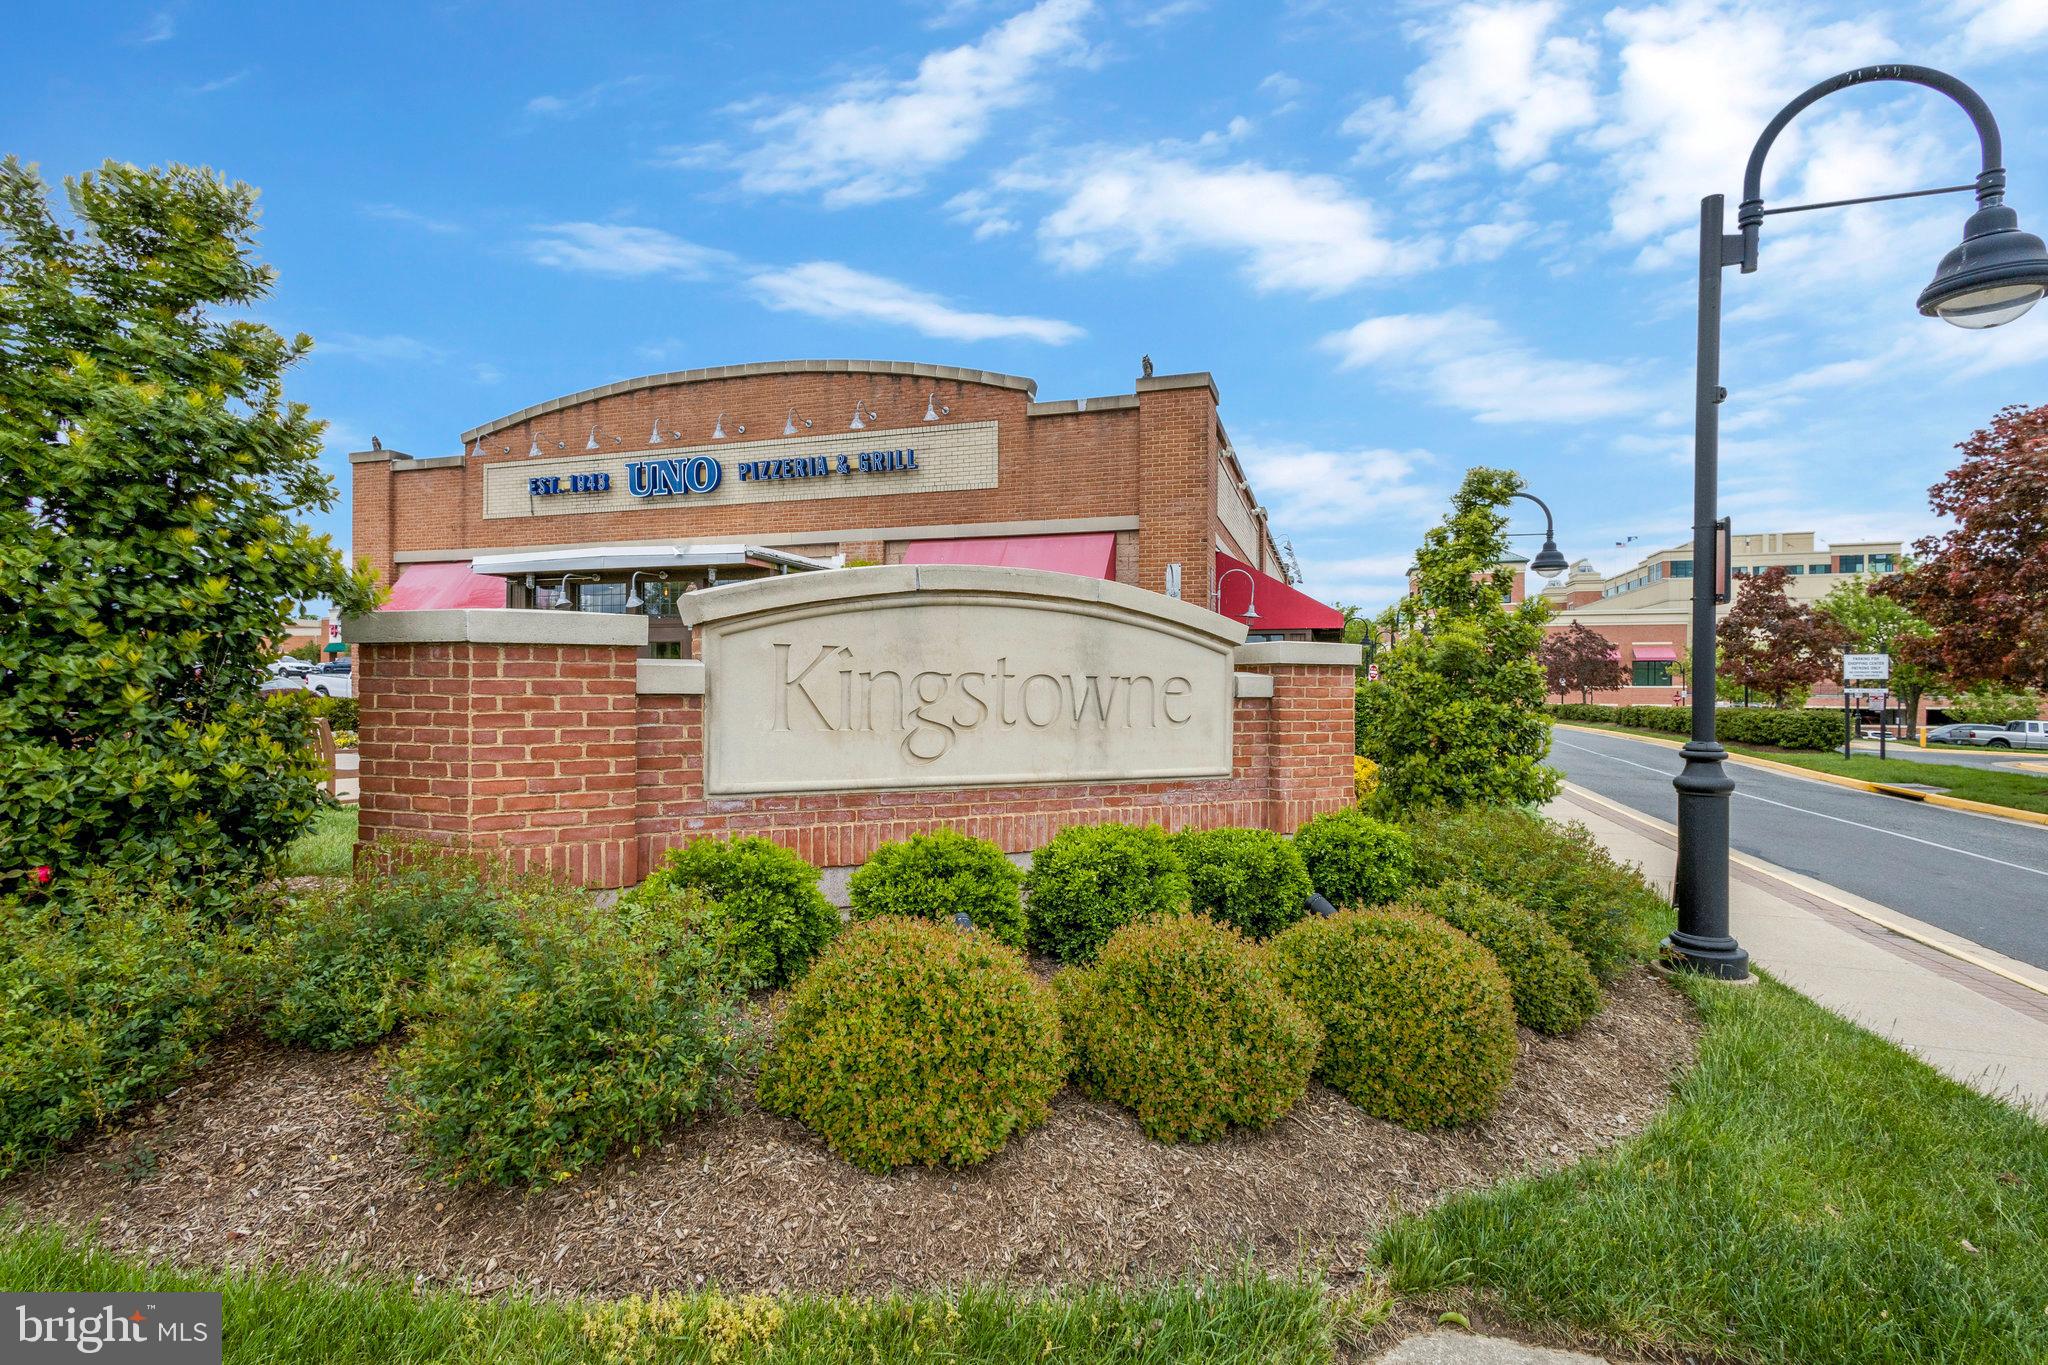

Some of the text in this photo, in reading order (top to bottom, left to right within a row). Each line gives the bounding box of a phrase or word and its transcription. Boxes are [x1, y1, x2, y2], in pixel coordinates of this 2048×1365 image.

[528, 448, 919, 498] EST. 1943 UNO PIZZERIA & GRILL
[771, 642, 1194, 766] Kingstowne
